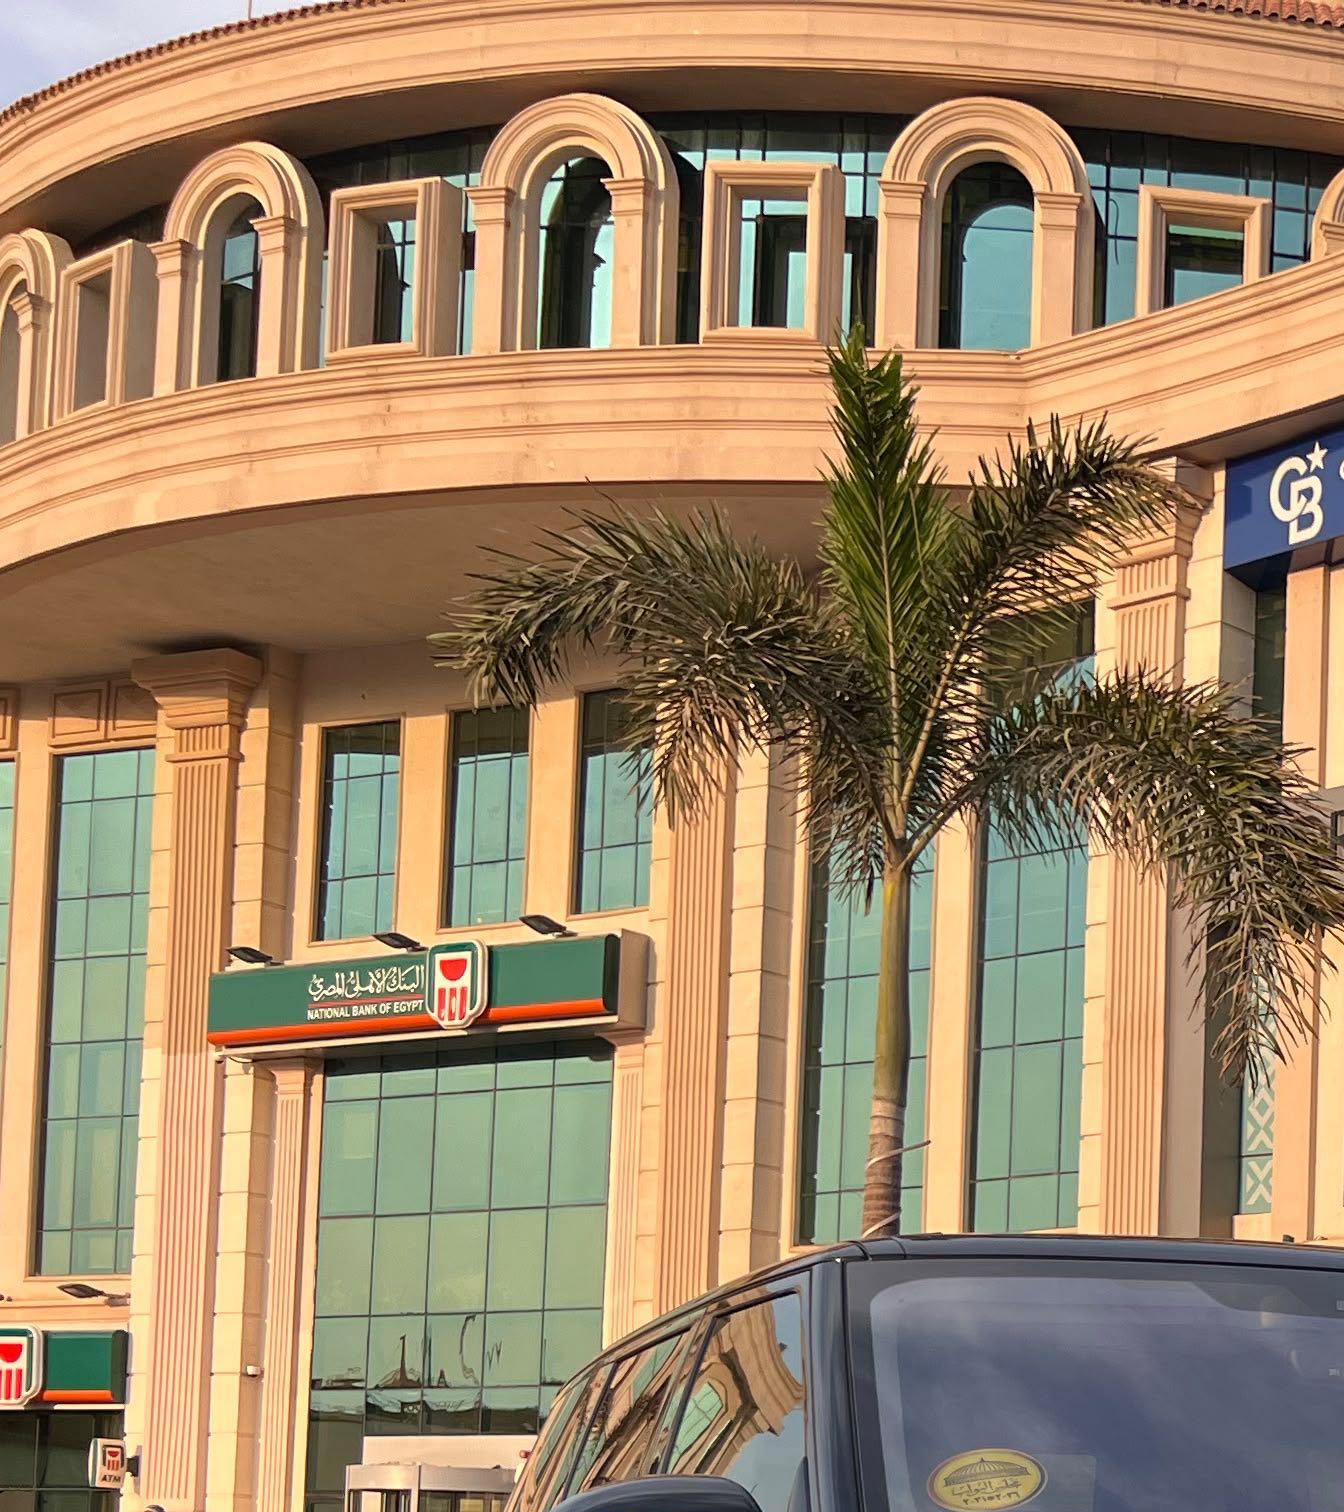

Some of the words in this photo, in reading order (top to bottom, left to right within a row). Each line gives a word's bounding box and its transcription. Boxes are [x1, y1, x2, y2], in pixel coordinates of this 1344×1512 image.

[386, 964, 425, 993] البنك
[307, 1007, 350, 1021] NATIONAL
[352, 1004, 377, 1017] BANK
[379, 1002, 392, 1014] OF
[393, 1000, 425, 1013] EGYPT
[100, 1474, 122, 1483] ATM
